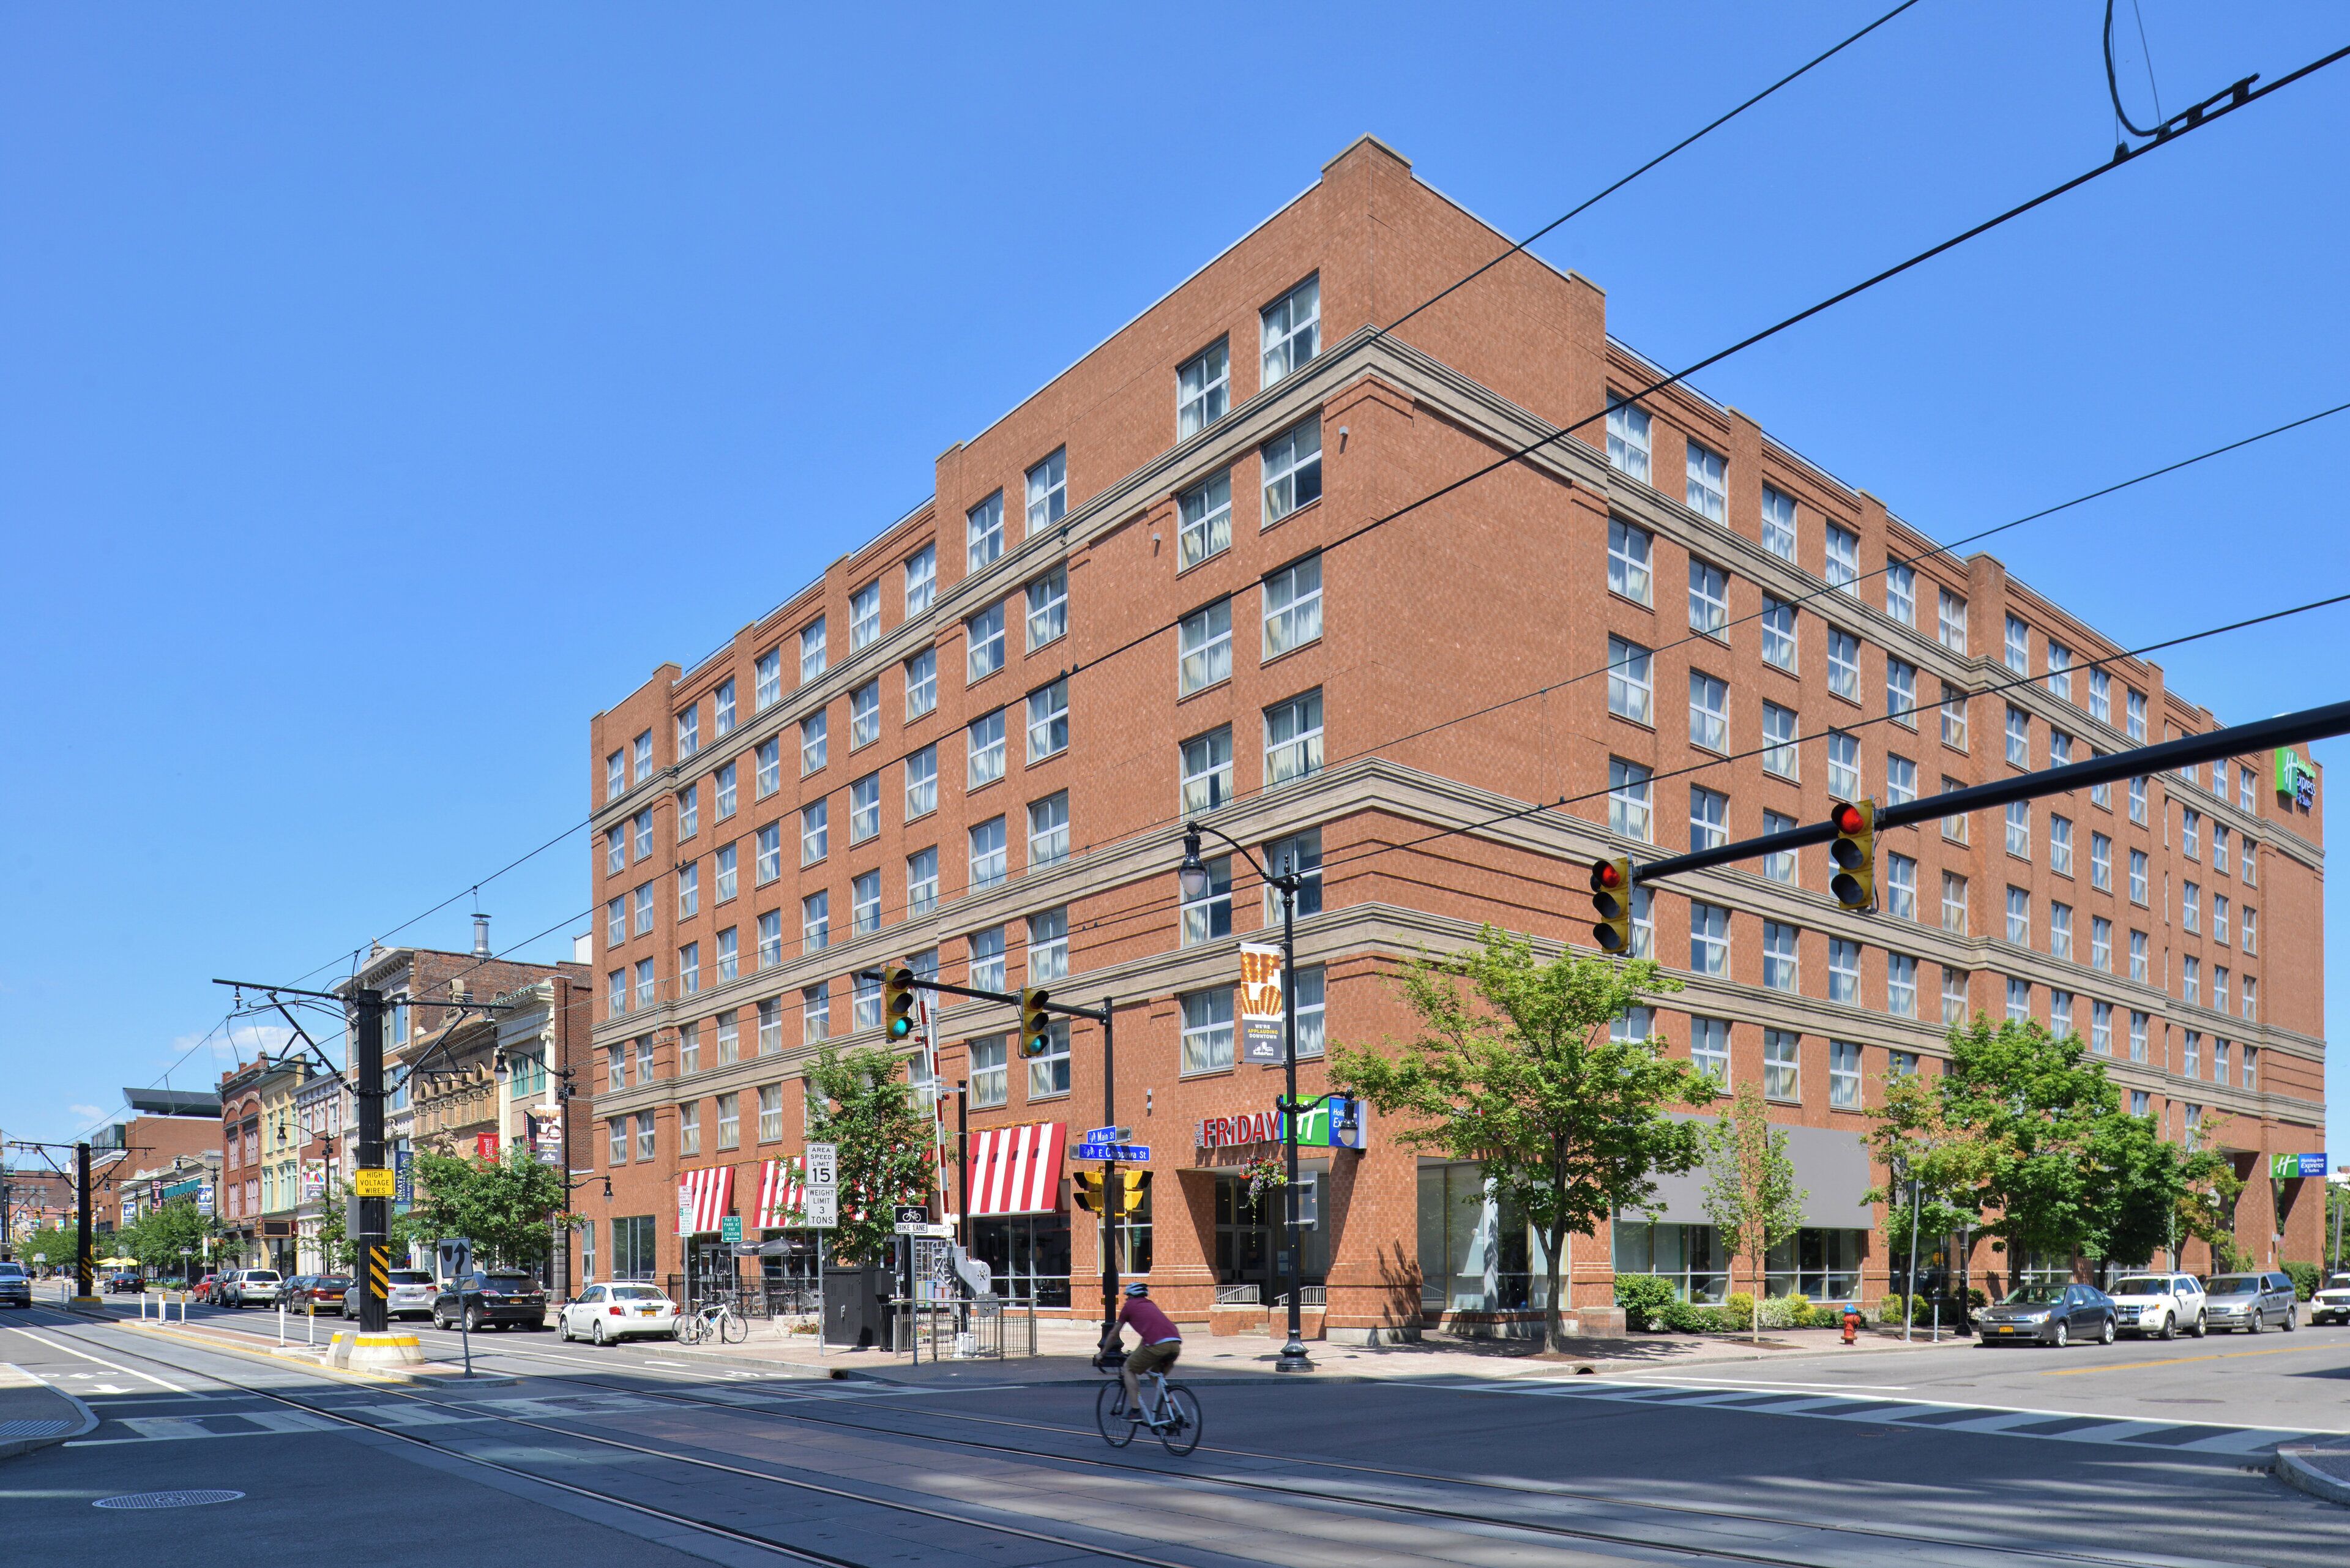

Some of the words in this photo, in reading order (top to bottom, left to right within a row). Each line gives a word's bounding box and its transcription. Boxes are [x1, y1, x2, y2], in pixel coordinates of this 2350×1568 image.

[1097, 1131, 1108, 1141] Main
[1105, 1147, 1136, 1159] Chippewa
[1140, 1151, 1146, 1159] St
[813, 1168, 830, 1182] 15
